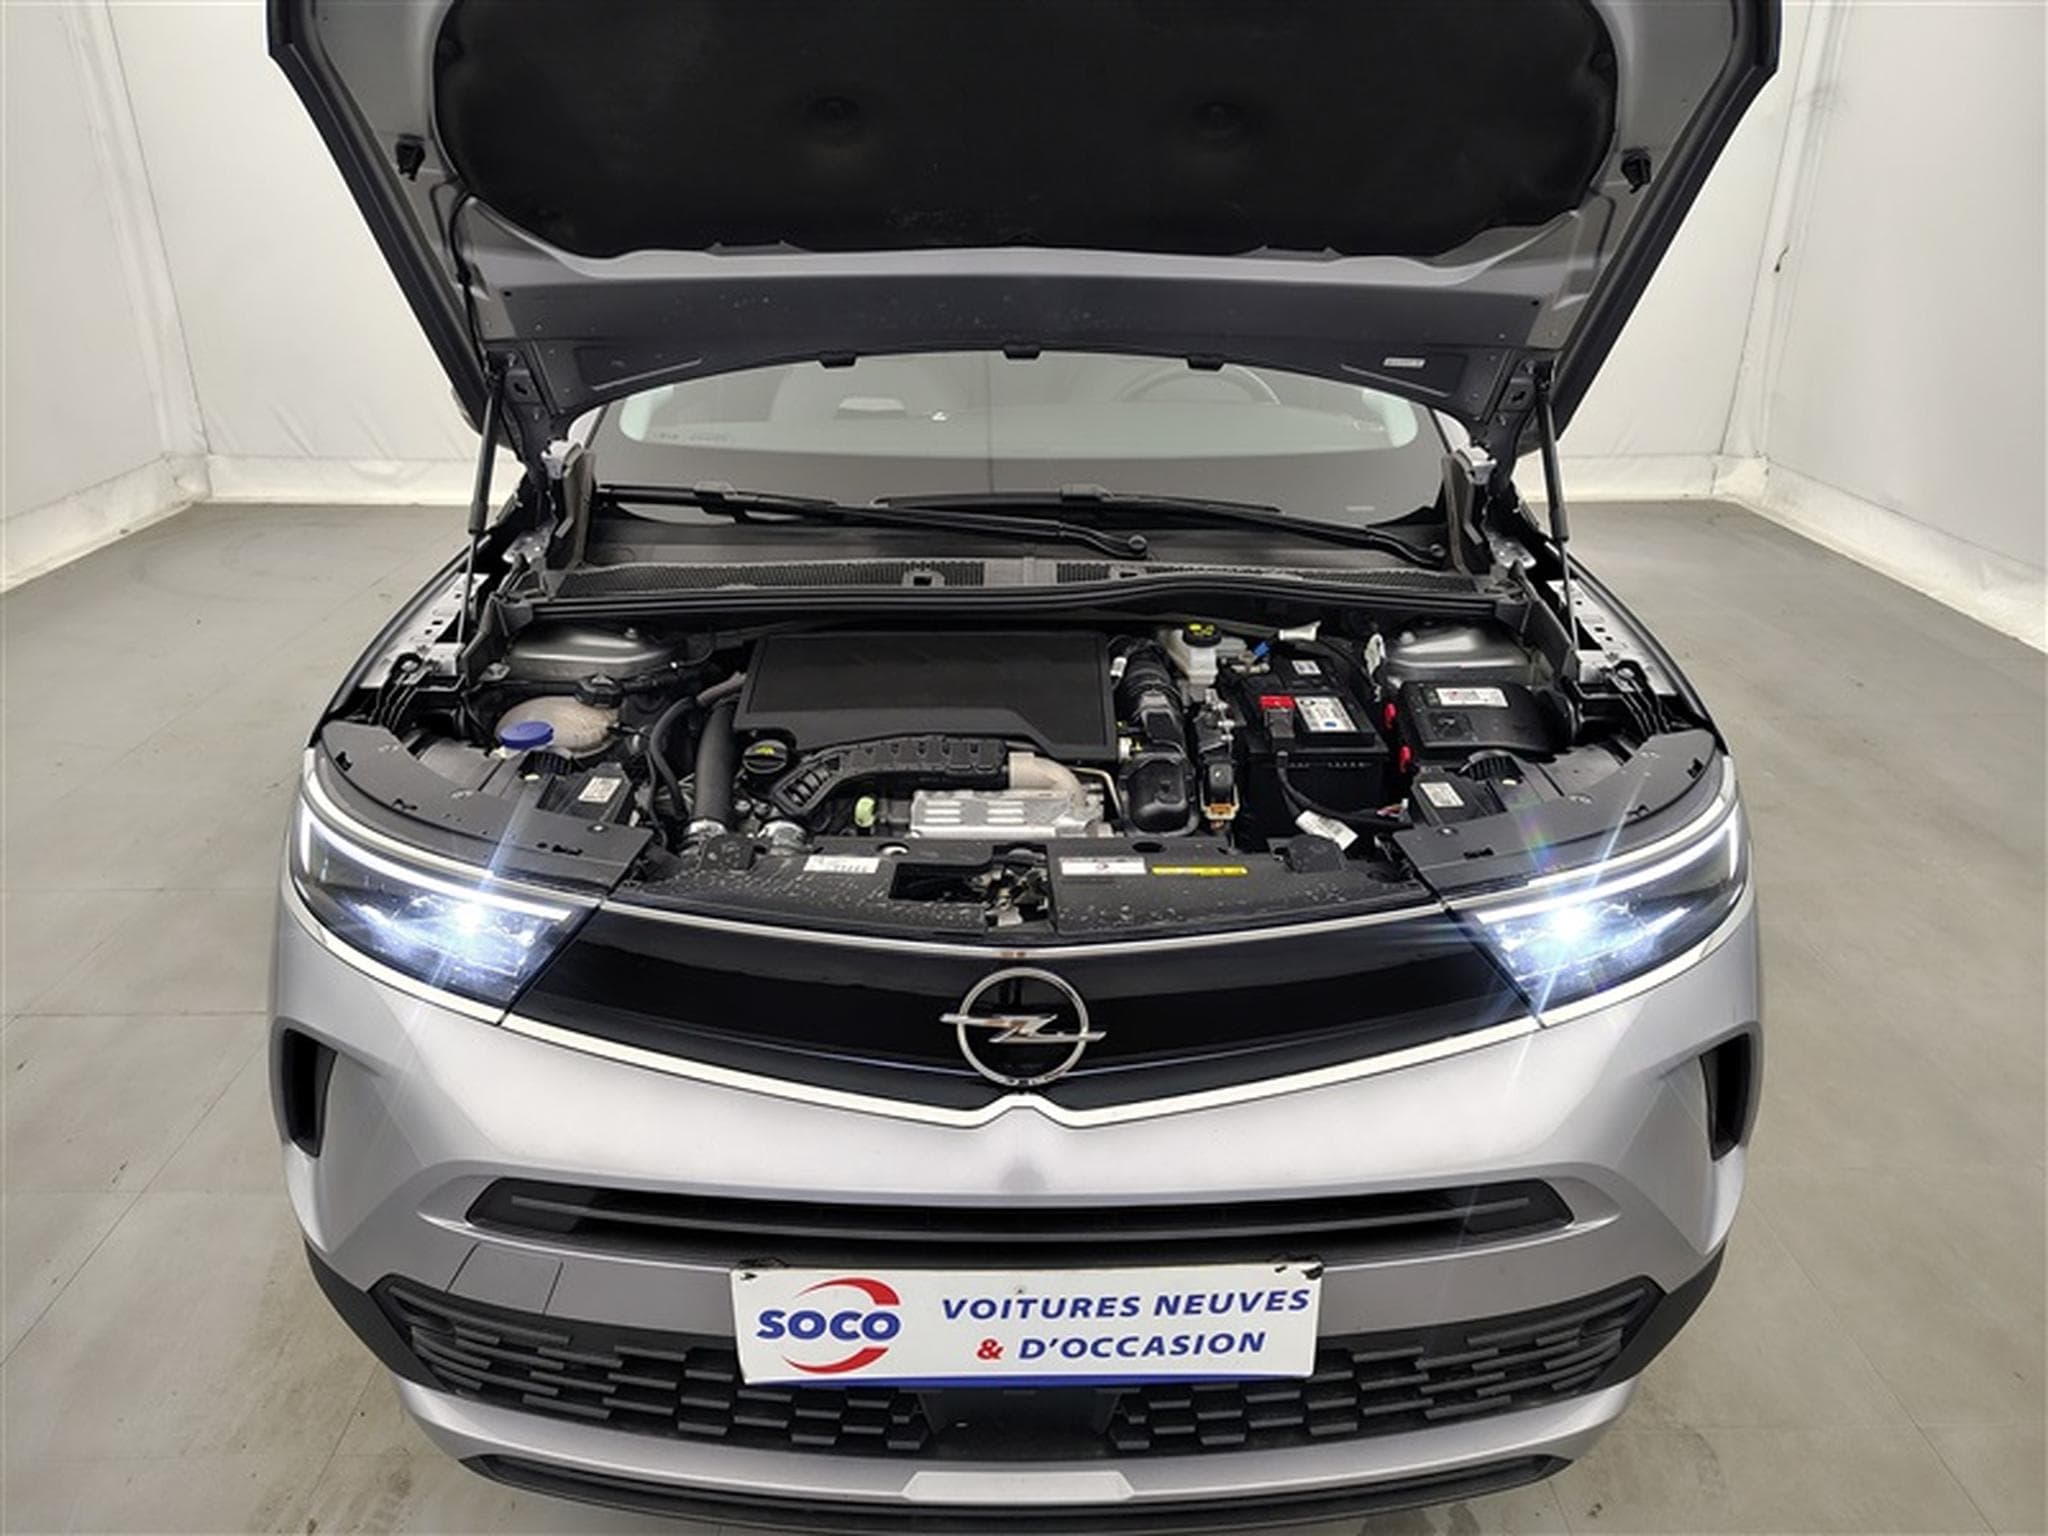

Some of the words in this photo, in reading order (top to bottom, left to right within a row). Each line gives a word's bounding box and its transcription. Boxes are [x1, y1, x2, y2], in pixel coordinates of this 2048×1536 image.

[943, 1297, 1140, 1320] VOITURES
[1157, 1289, 1311, 1314] NEUVES
[757, 1309, 902, 1341] SOCO
[976, 1339, 1003, 1361] &
[1019, 1331, 1267, 1359] D'OCCASION
